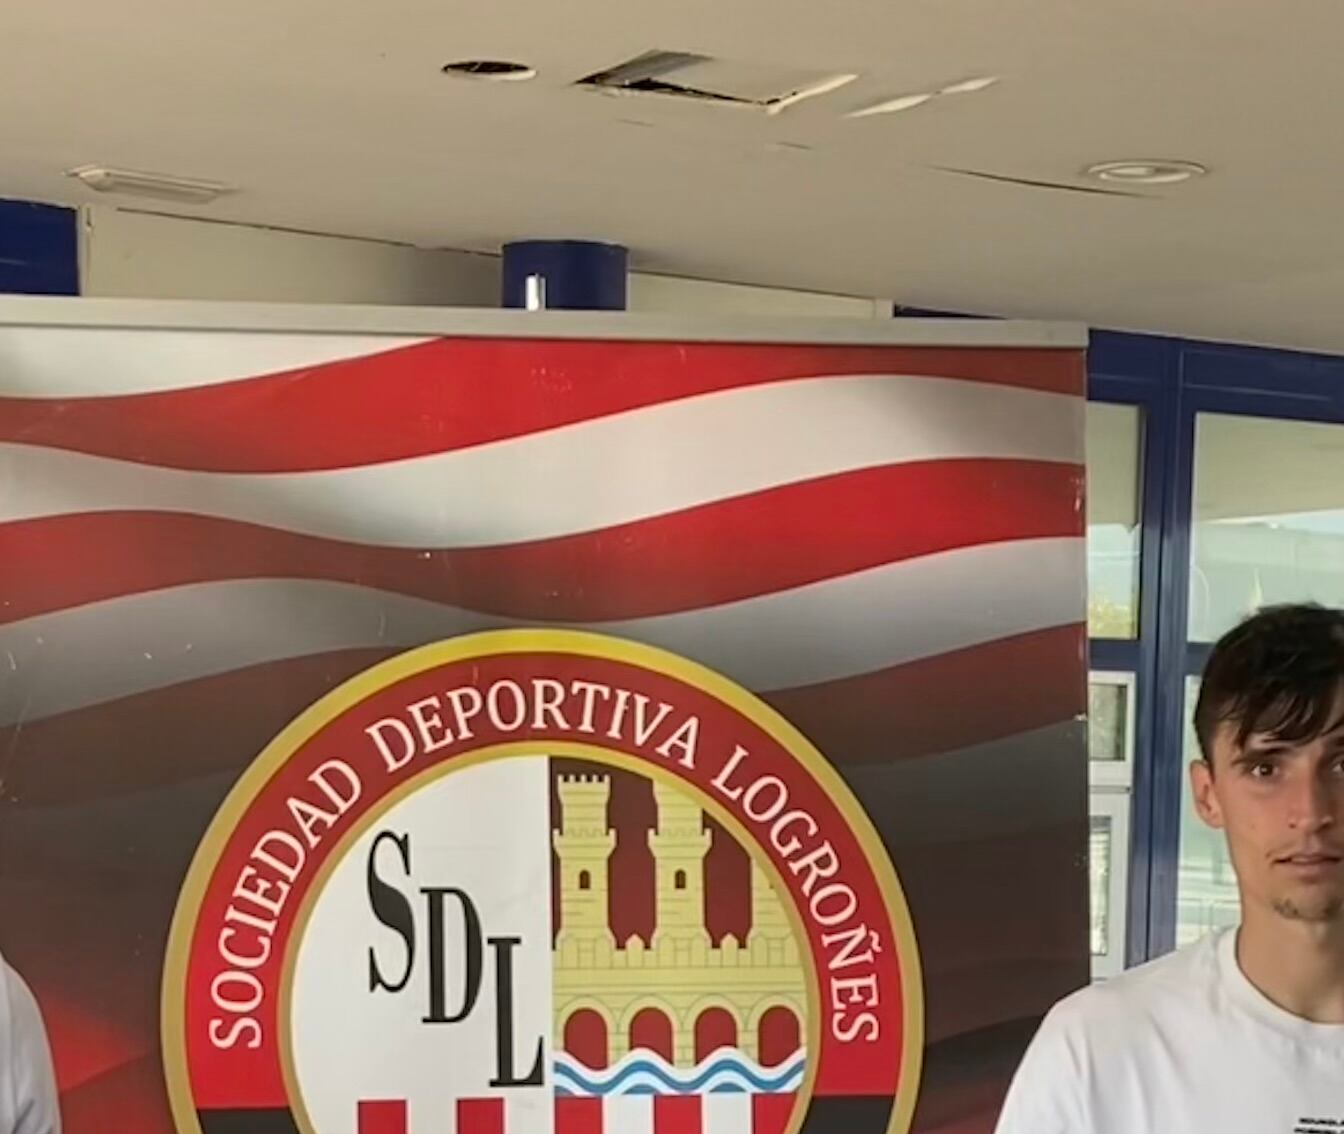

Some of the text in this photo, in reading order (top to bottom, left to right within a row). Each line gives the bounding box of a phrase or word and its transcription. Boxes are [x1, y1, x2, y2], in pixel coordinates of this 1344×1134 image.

[209, 677, 883, 1050] SOCIEDAD DEPORTIVA LOGROÑES
[366, 829, 545, 1089] SDL
